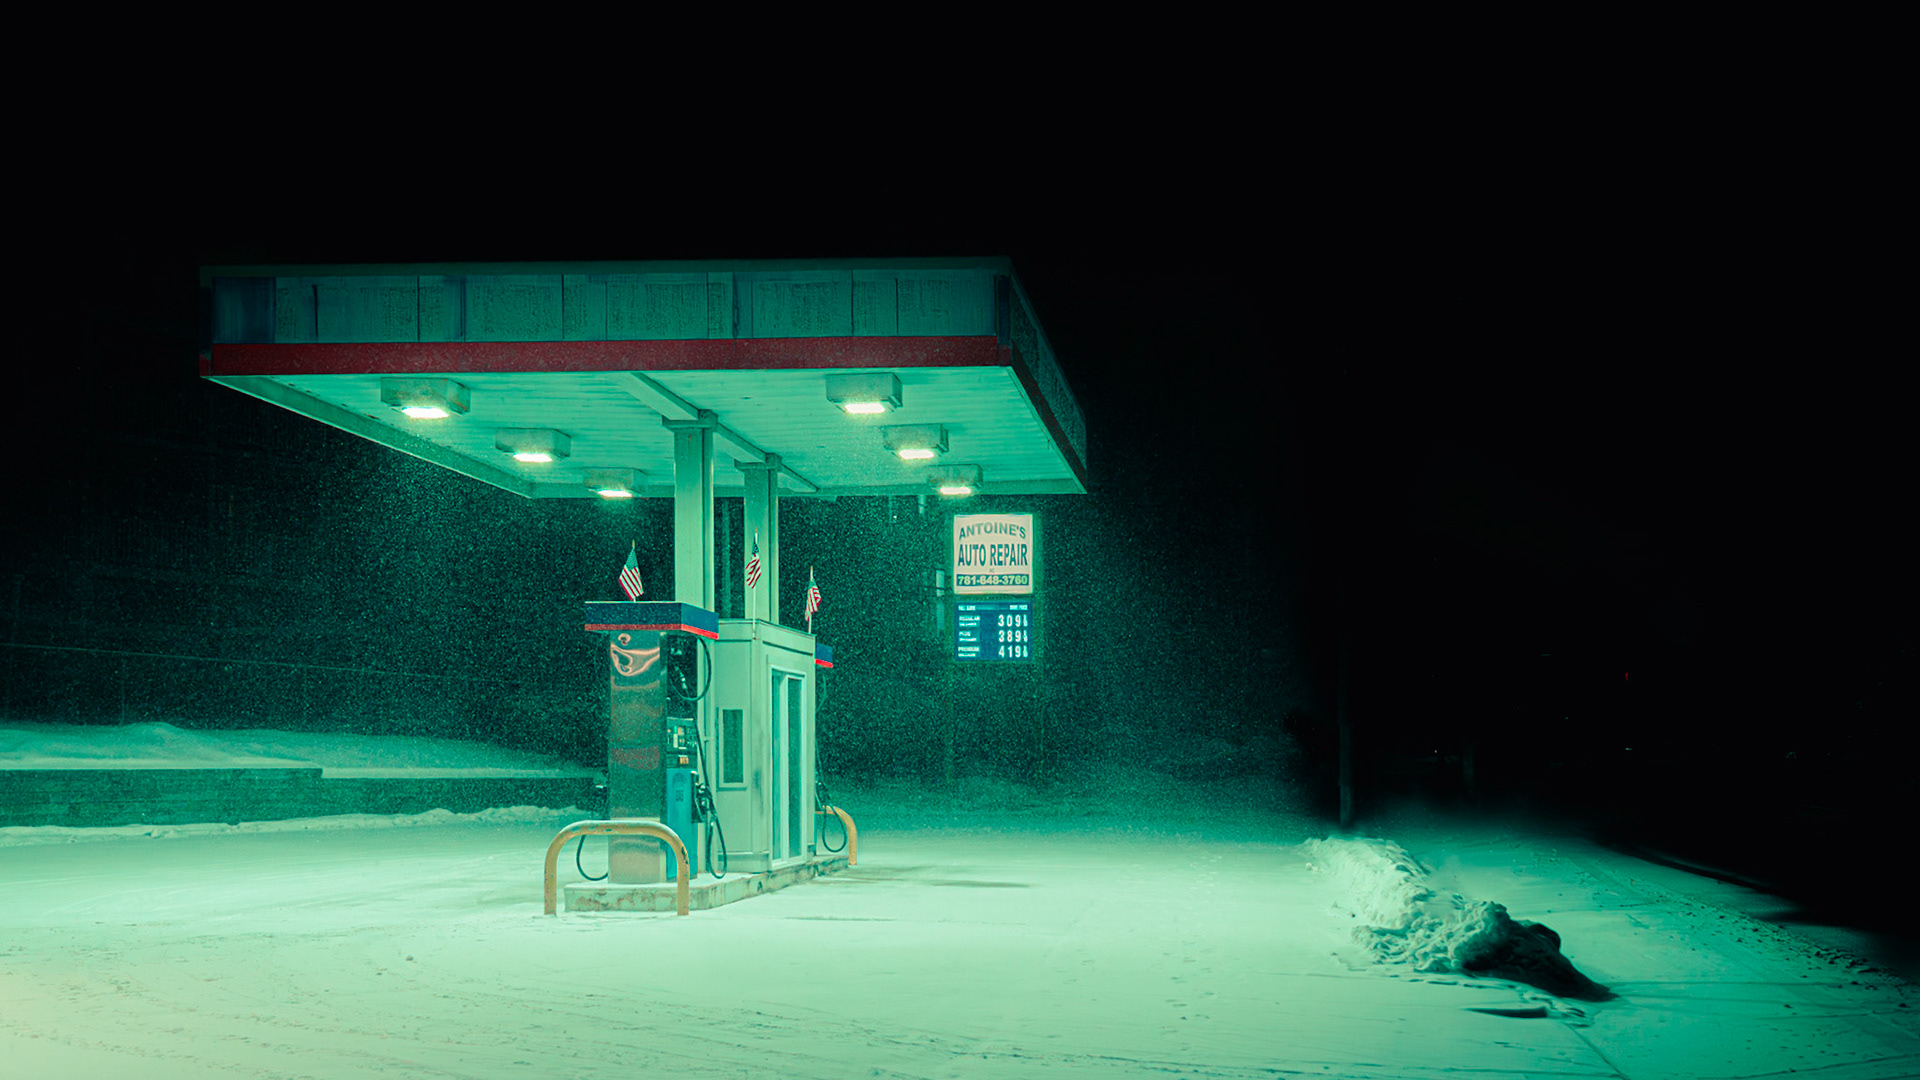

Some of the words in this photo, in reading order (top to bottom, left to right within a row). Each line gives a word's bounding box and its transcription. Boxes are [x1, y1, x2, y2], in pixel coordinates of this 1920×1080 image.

[959, 522, 1026, 540] ANTOINE'S
[958, 543, 986, 566] AUTO
[990, 543, 1028, 566] REPAIR
[958, 575, 1028, 585] 781-648-3760
